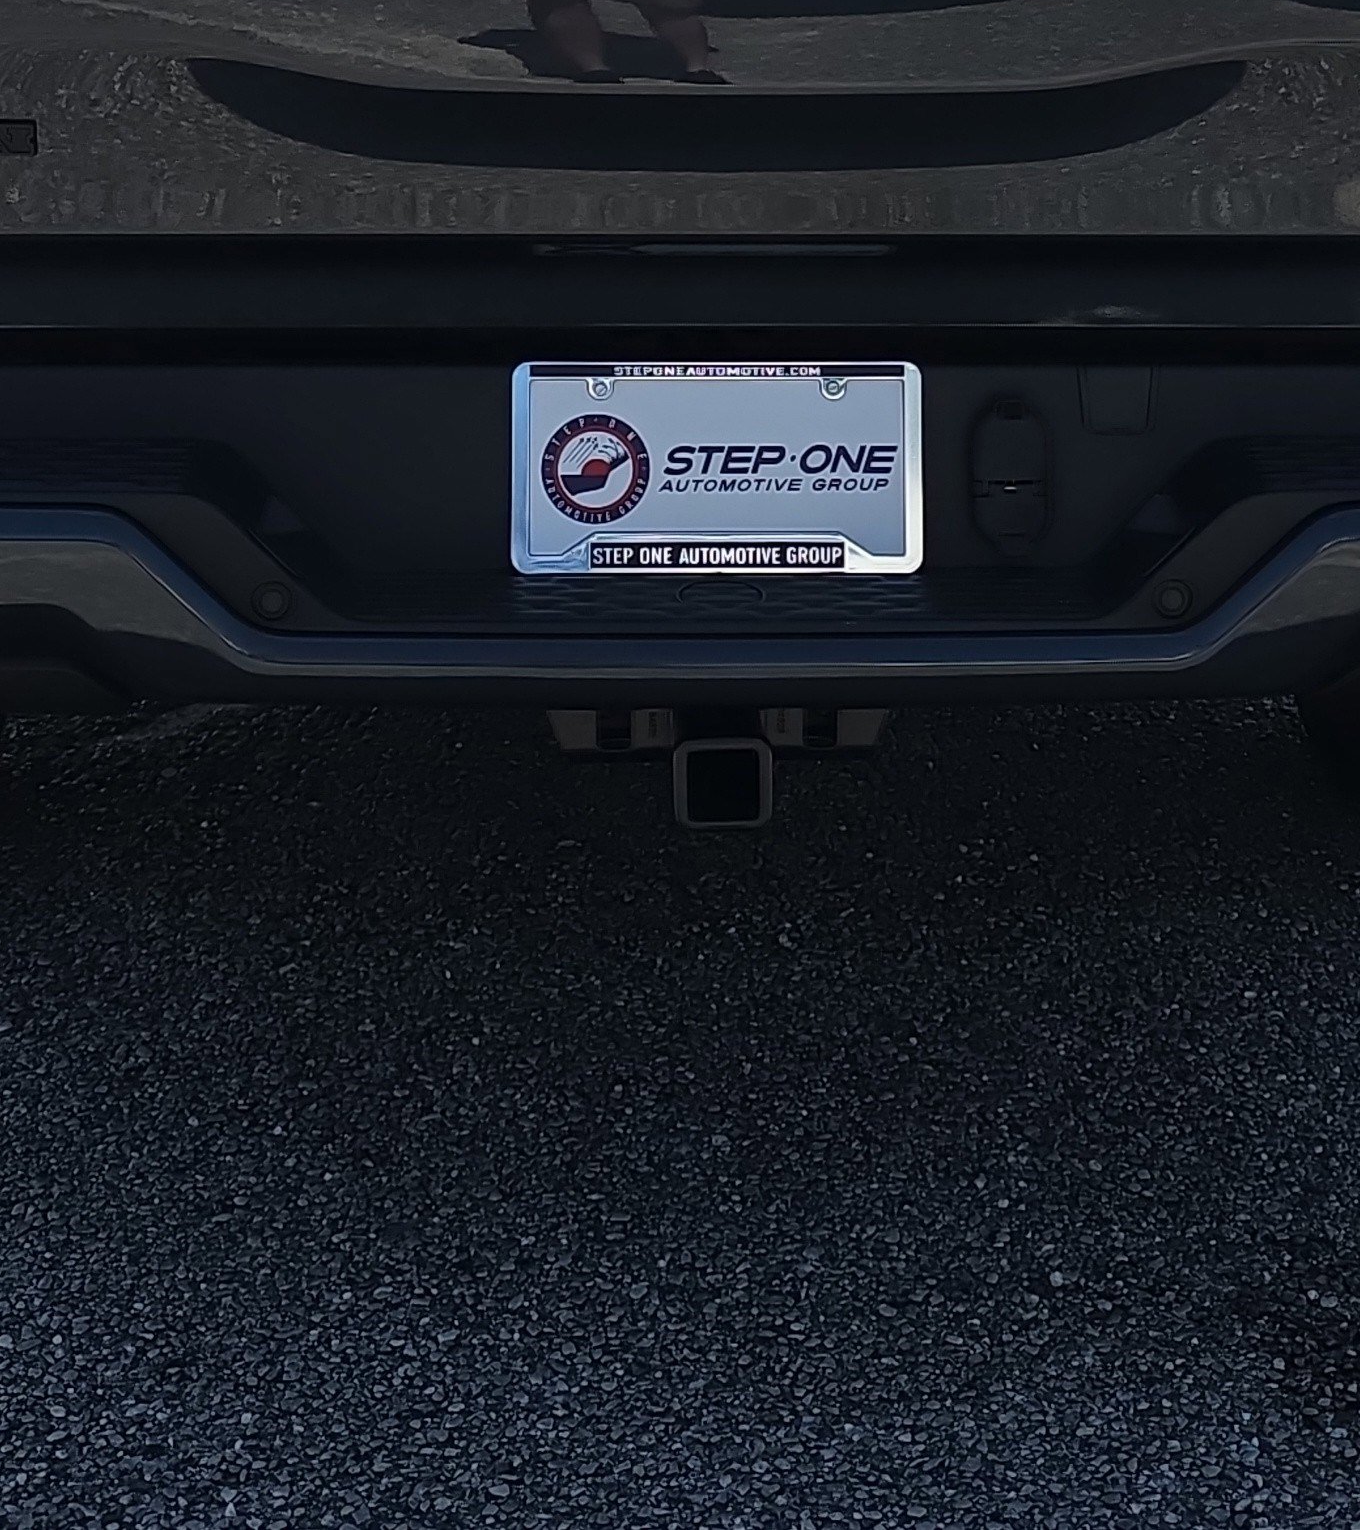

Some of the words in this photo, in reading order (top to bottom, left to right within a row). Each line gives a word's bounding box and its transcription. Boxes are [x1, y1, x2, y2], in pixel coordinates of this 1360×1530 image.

[613, 366, 821, 377] STEPONEAUTOMOTIVE.COM
[658, 478, 802, 493] AUTOMOTIVE
[812, 478, 890, 493] GROUP
[593, 547, 633, 565] STEP
[639, 547, 672, 565] ONE
[679, 547, 781, 565] AUTOMOTIVE
[786, 546, 842, 565] GROUP
